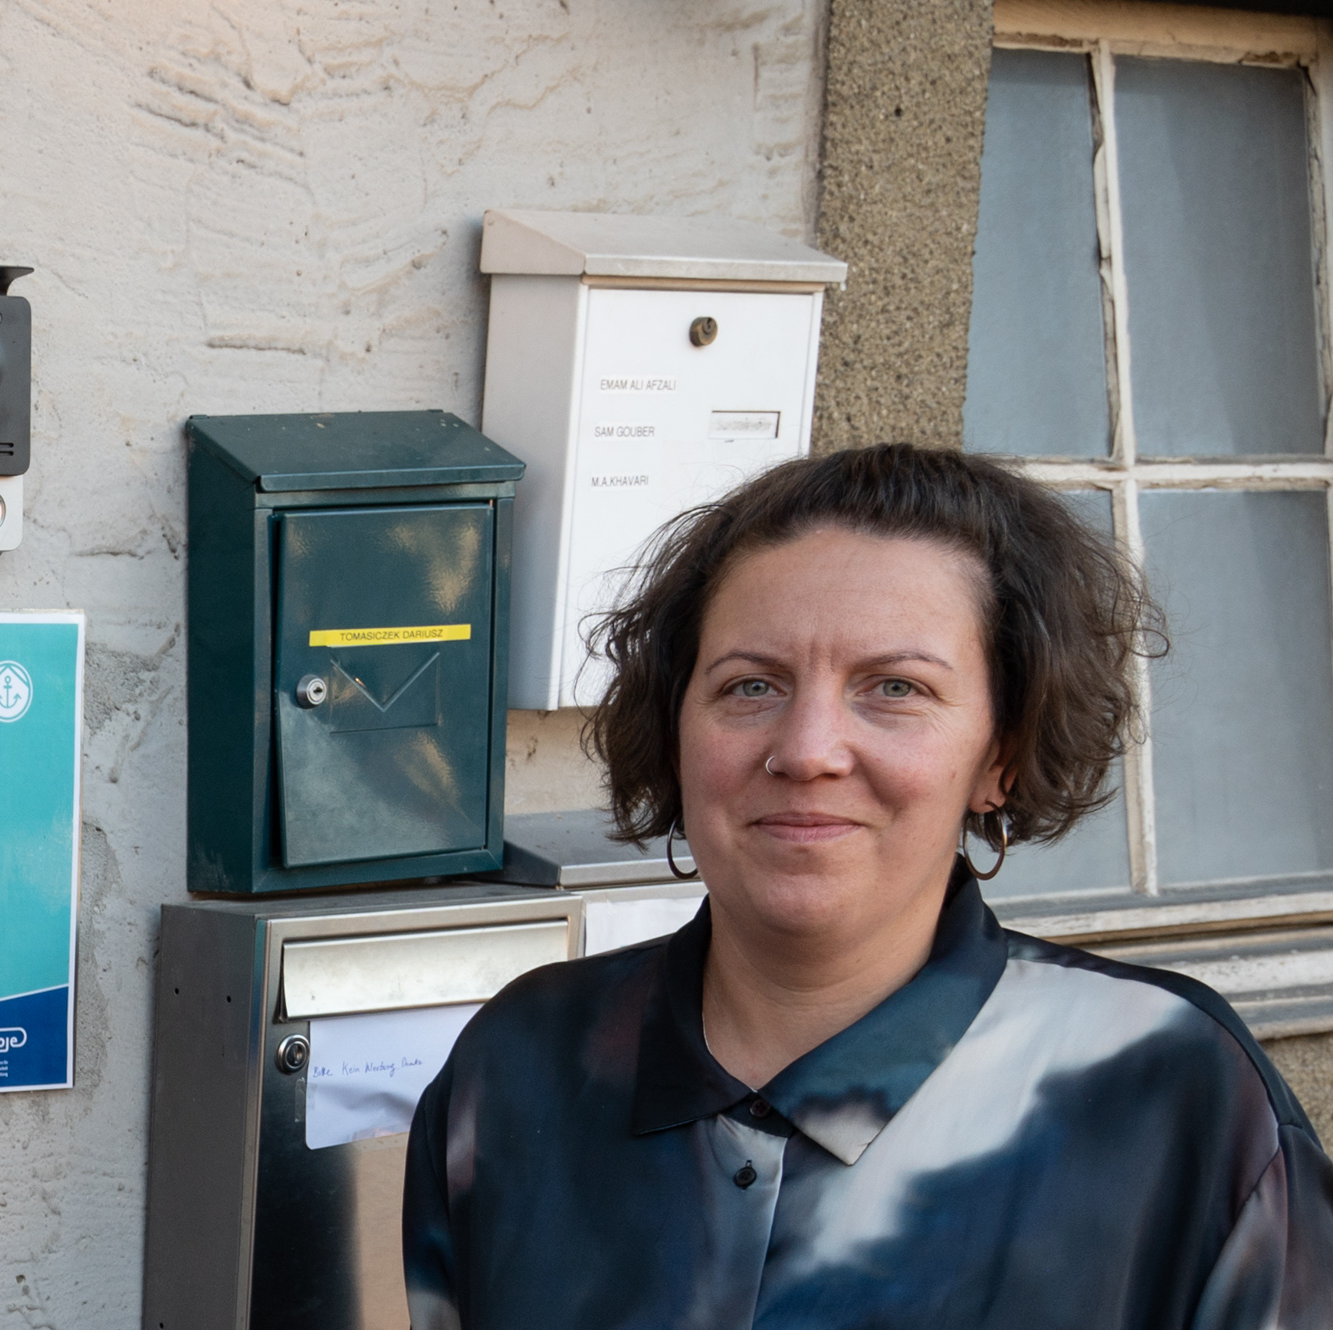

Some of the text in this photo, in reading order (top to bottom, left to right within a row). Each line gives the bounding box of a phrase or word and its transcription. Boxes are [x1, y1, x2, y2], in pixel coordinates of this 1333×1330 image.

[600, 379, 676, 391] EMAM ALI AFZALI
[594, 426, 655, 437] SAM GOUBER
[340, 628, 443, 641] TOMASICZEK DARIUSZ
